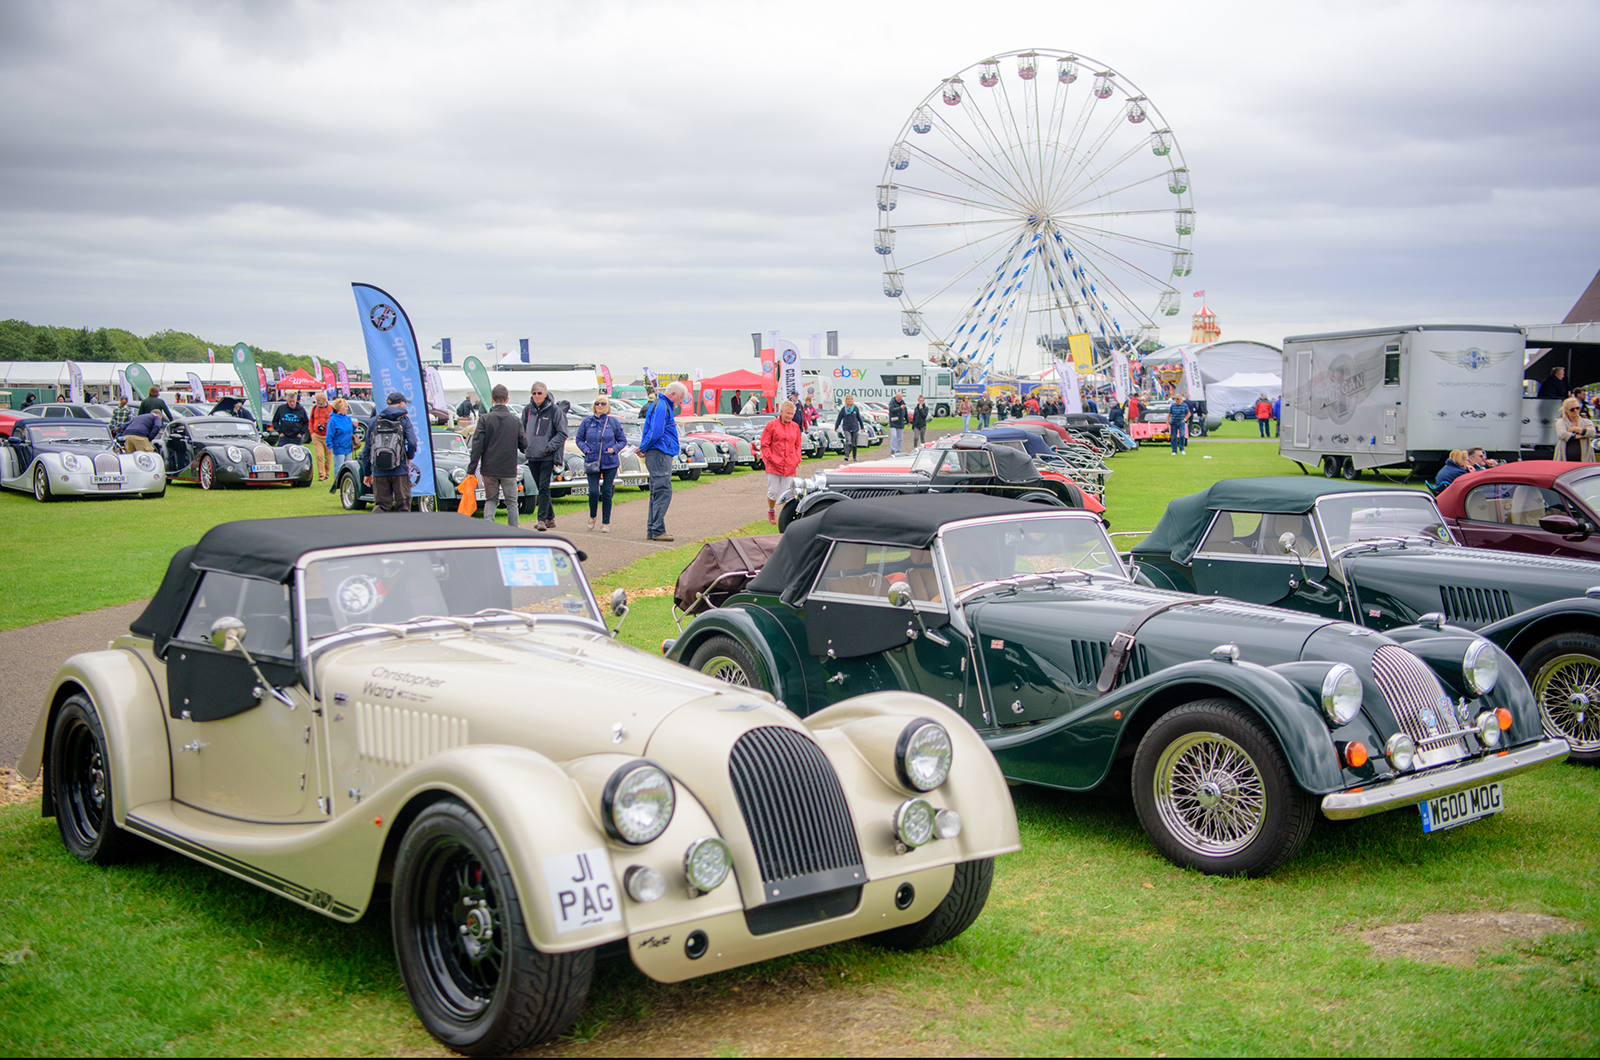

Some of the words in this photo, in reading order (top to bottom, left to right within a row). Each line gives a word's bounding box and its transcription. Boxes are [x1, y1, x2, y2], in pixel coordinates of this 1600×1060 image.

[392, 337, 409, 371] Club
[833, 365, 867, 380] ebay
[1321, 371, 1365, 402] MORGAN
[521, 559, 530, 571] 3
[538, 559, 547, 571] 8
[362, 681, 397, 699] Ward
[371, 666, 447, 688] Christopher
[1430, 792, 1467, 826] W600
[1469, 783, 1501, 815] MOG
[558, 883, 613, 921] PAG
